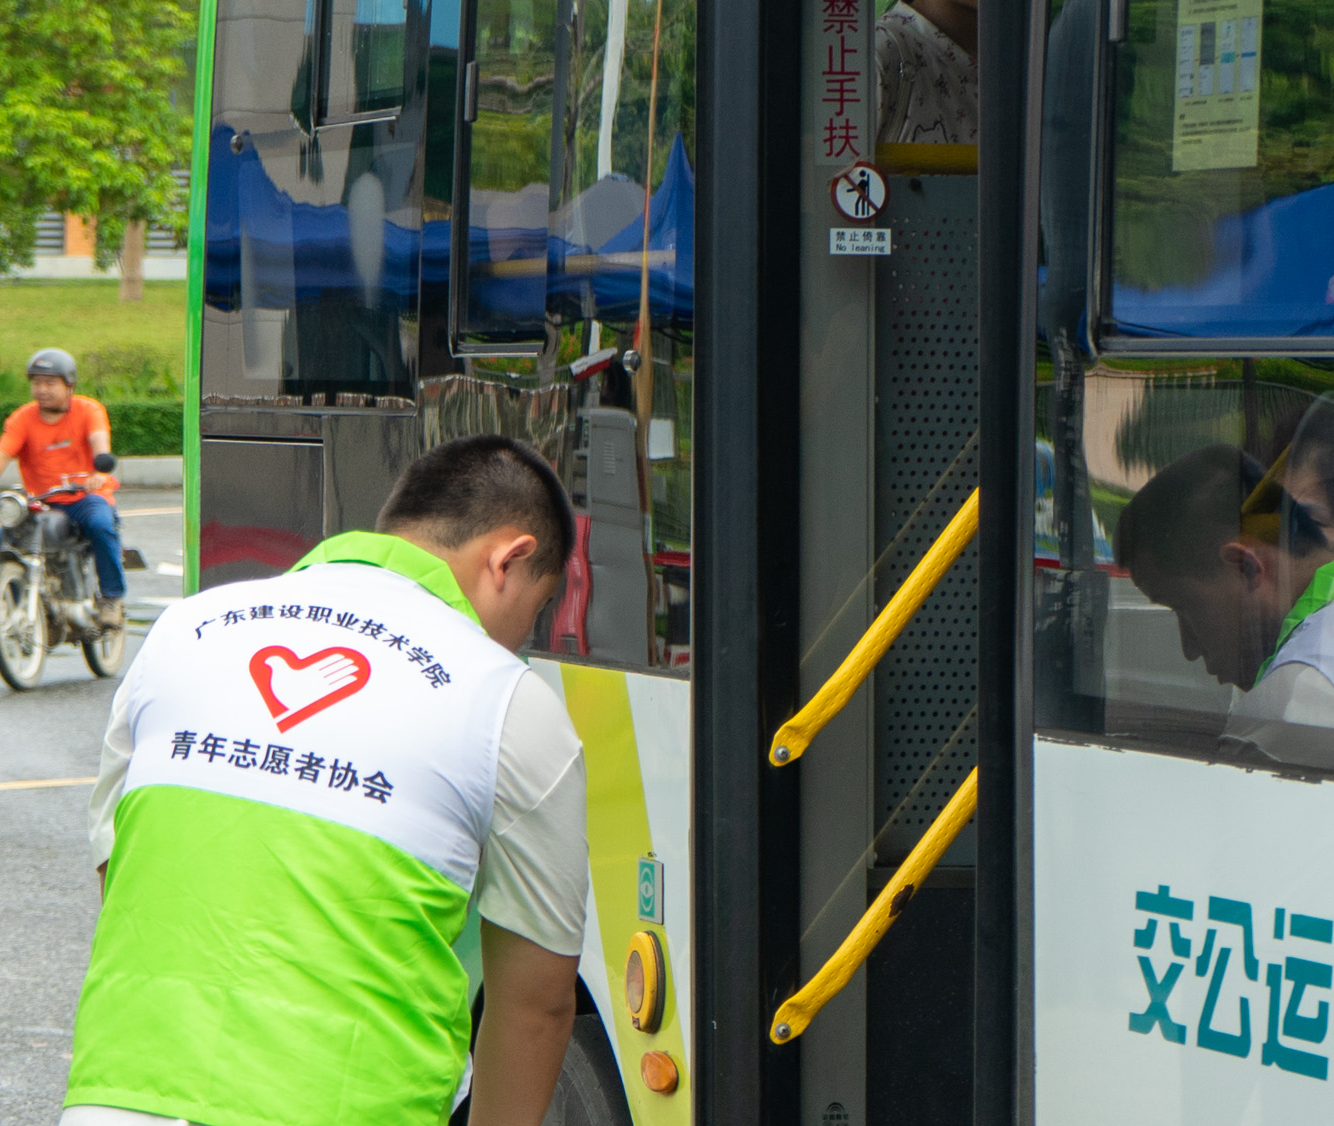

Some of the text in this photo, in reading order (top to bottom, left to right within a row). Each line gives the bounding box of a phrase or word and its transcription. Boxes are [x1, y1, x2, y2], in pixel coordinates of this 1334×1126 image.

[822, 0, 861, 158] 禁止手扶
[835, 231, 886, 243] 禁止倚靠
[836, 243, 885, 254] No leaning
[194, 604, 452, 689] 广东建设职业技术学院
[170, 730, 395, 804] 青年志愿者协会
